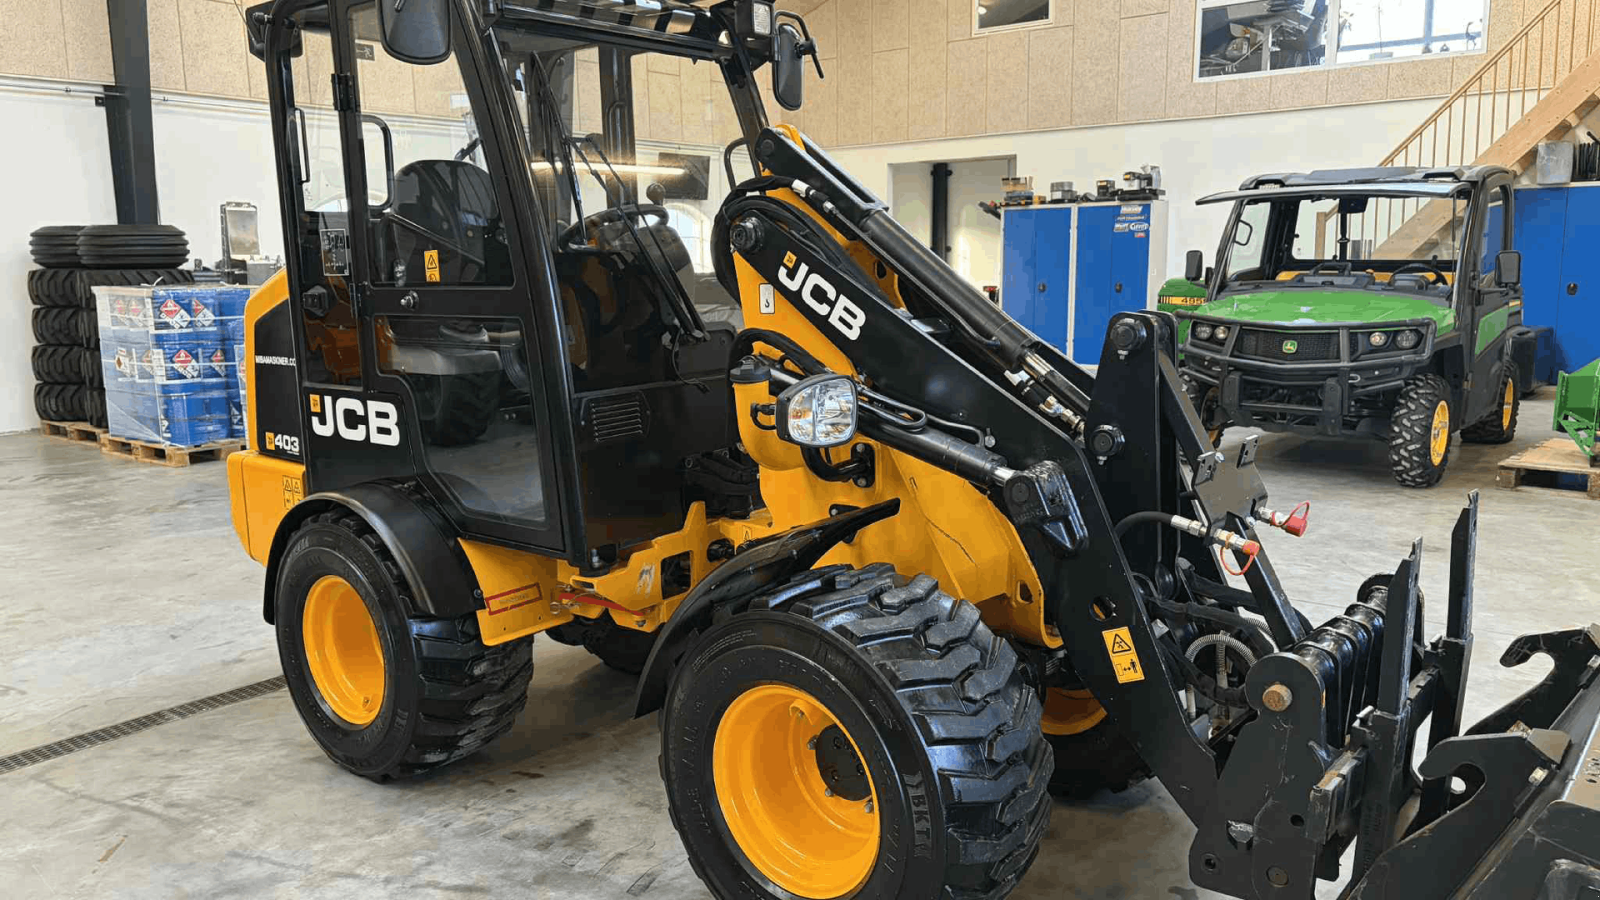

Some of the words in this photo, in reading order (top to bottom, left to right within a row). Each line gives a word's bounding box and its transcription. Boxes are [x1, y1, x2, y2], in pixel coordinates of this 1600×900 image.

[777, 261, 866, 340] JCB
[275, 434, 300, 452] 403
[310, 395, 400, 447] JCB
